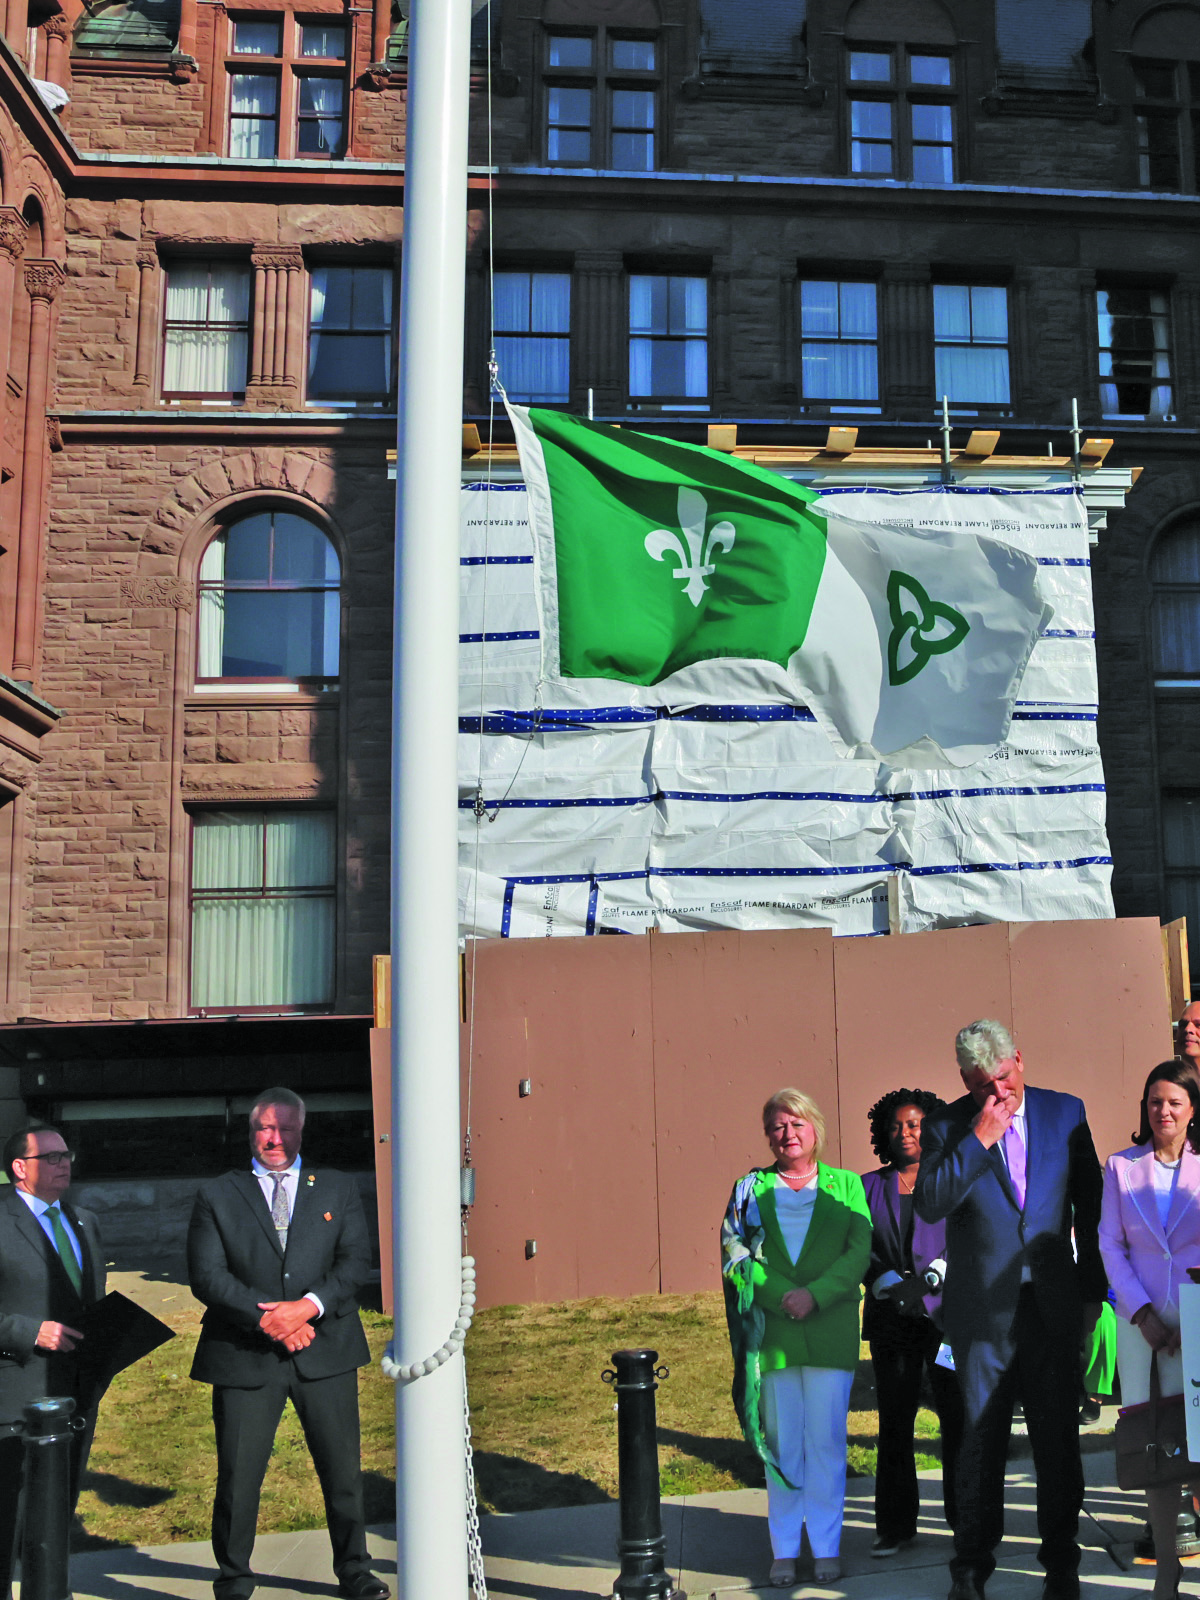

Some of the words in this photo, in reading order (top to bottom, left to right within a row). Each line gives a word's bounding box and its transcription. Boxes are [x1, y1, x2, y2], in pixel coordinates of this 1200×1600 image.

[919, 519, 963, 527] RETARDANT
[1025, 522, 1068, 530] RETARDANT
[1059, 748, 1084, 756] FLAME
[852, 895, 879, 905] FLAME
[744, 900, 770, 908] FLAME
[772, 901, 817, 910] RETARDANT
[622, 909, 649, 917] FLAME
